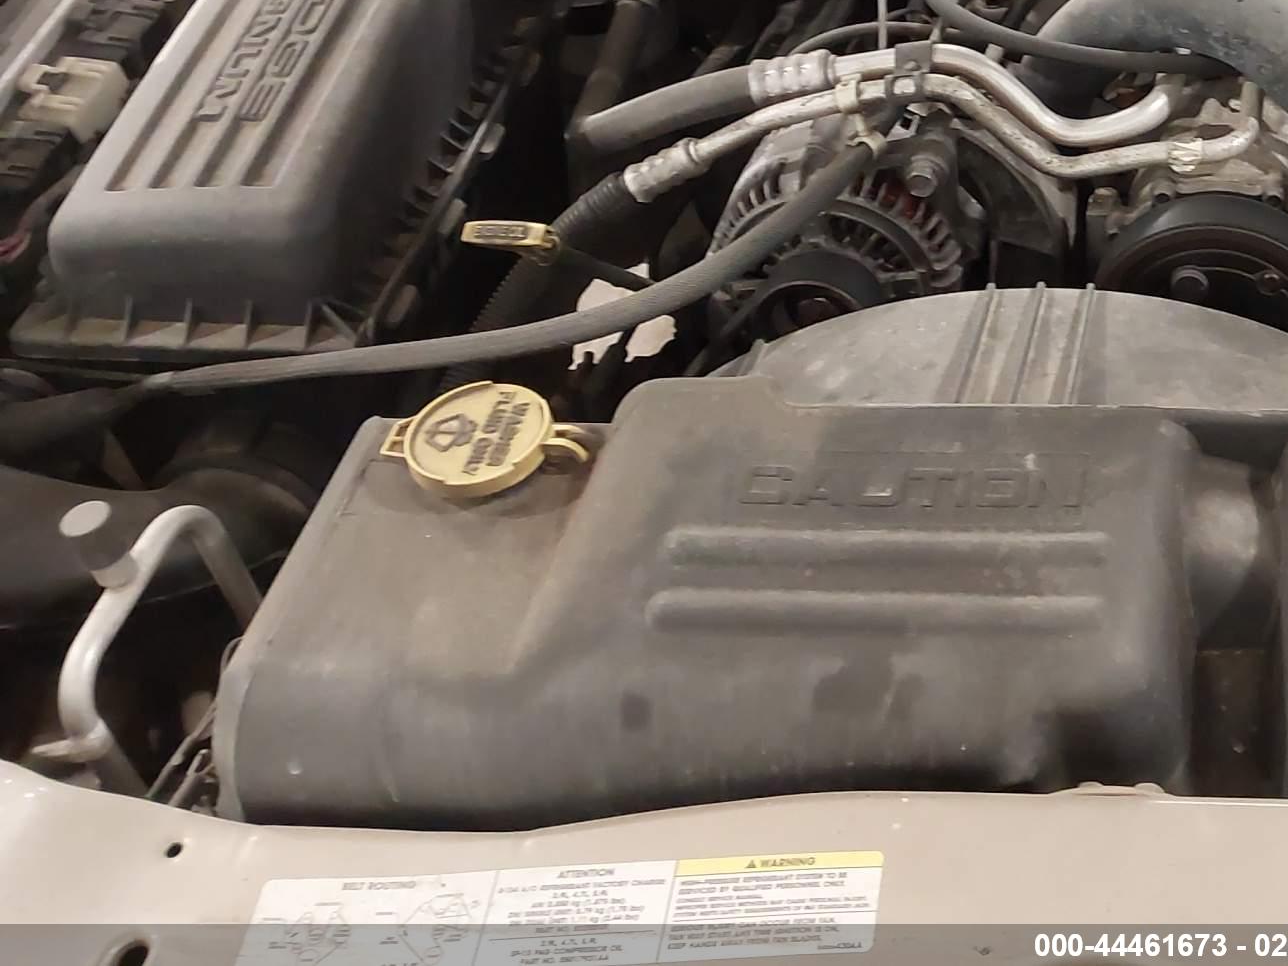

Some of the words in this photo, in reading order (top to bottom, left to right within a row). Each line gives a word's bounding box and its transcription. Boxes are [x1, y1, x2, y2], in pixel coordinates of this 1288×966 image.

[739, 463, 1090, 509] CAUTION
[759, 856, 816, 868] WARNING
[556, 868, 616, 879] ATTENTION
